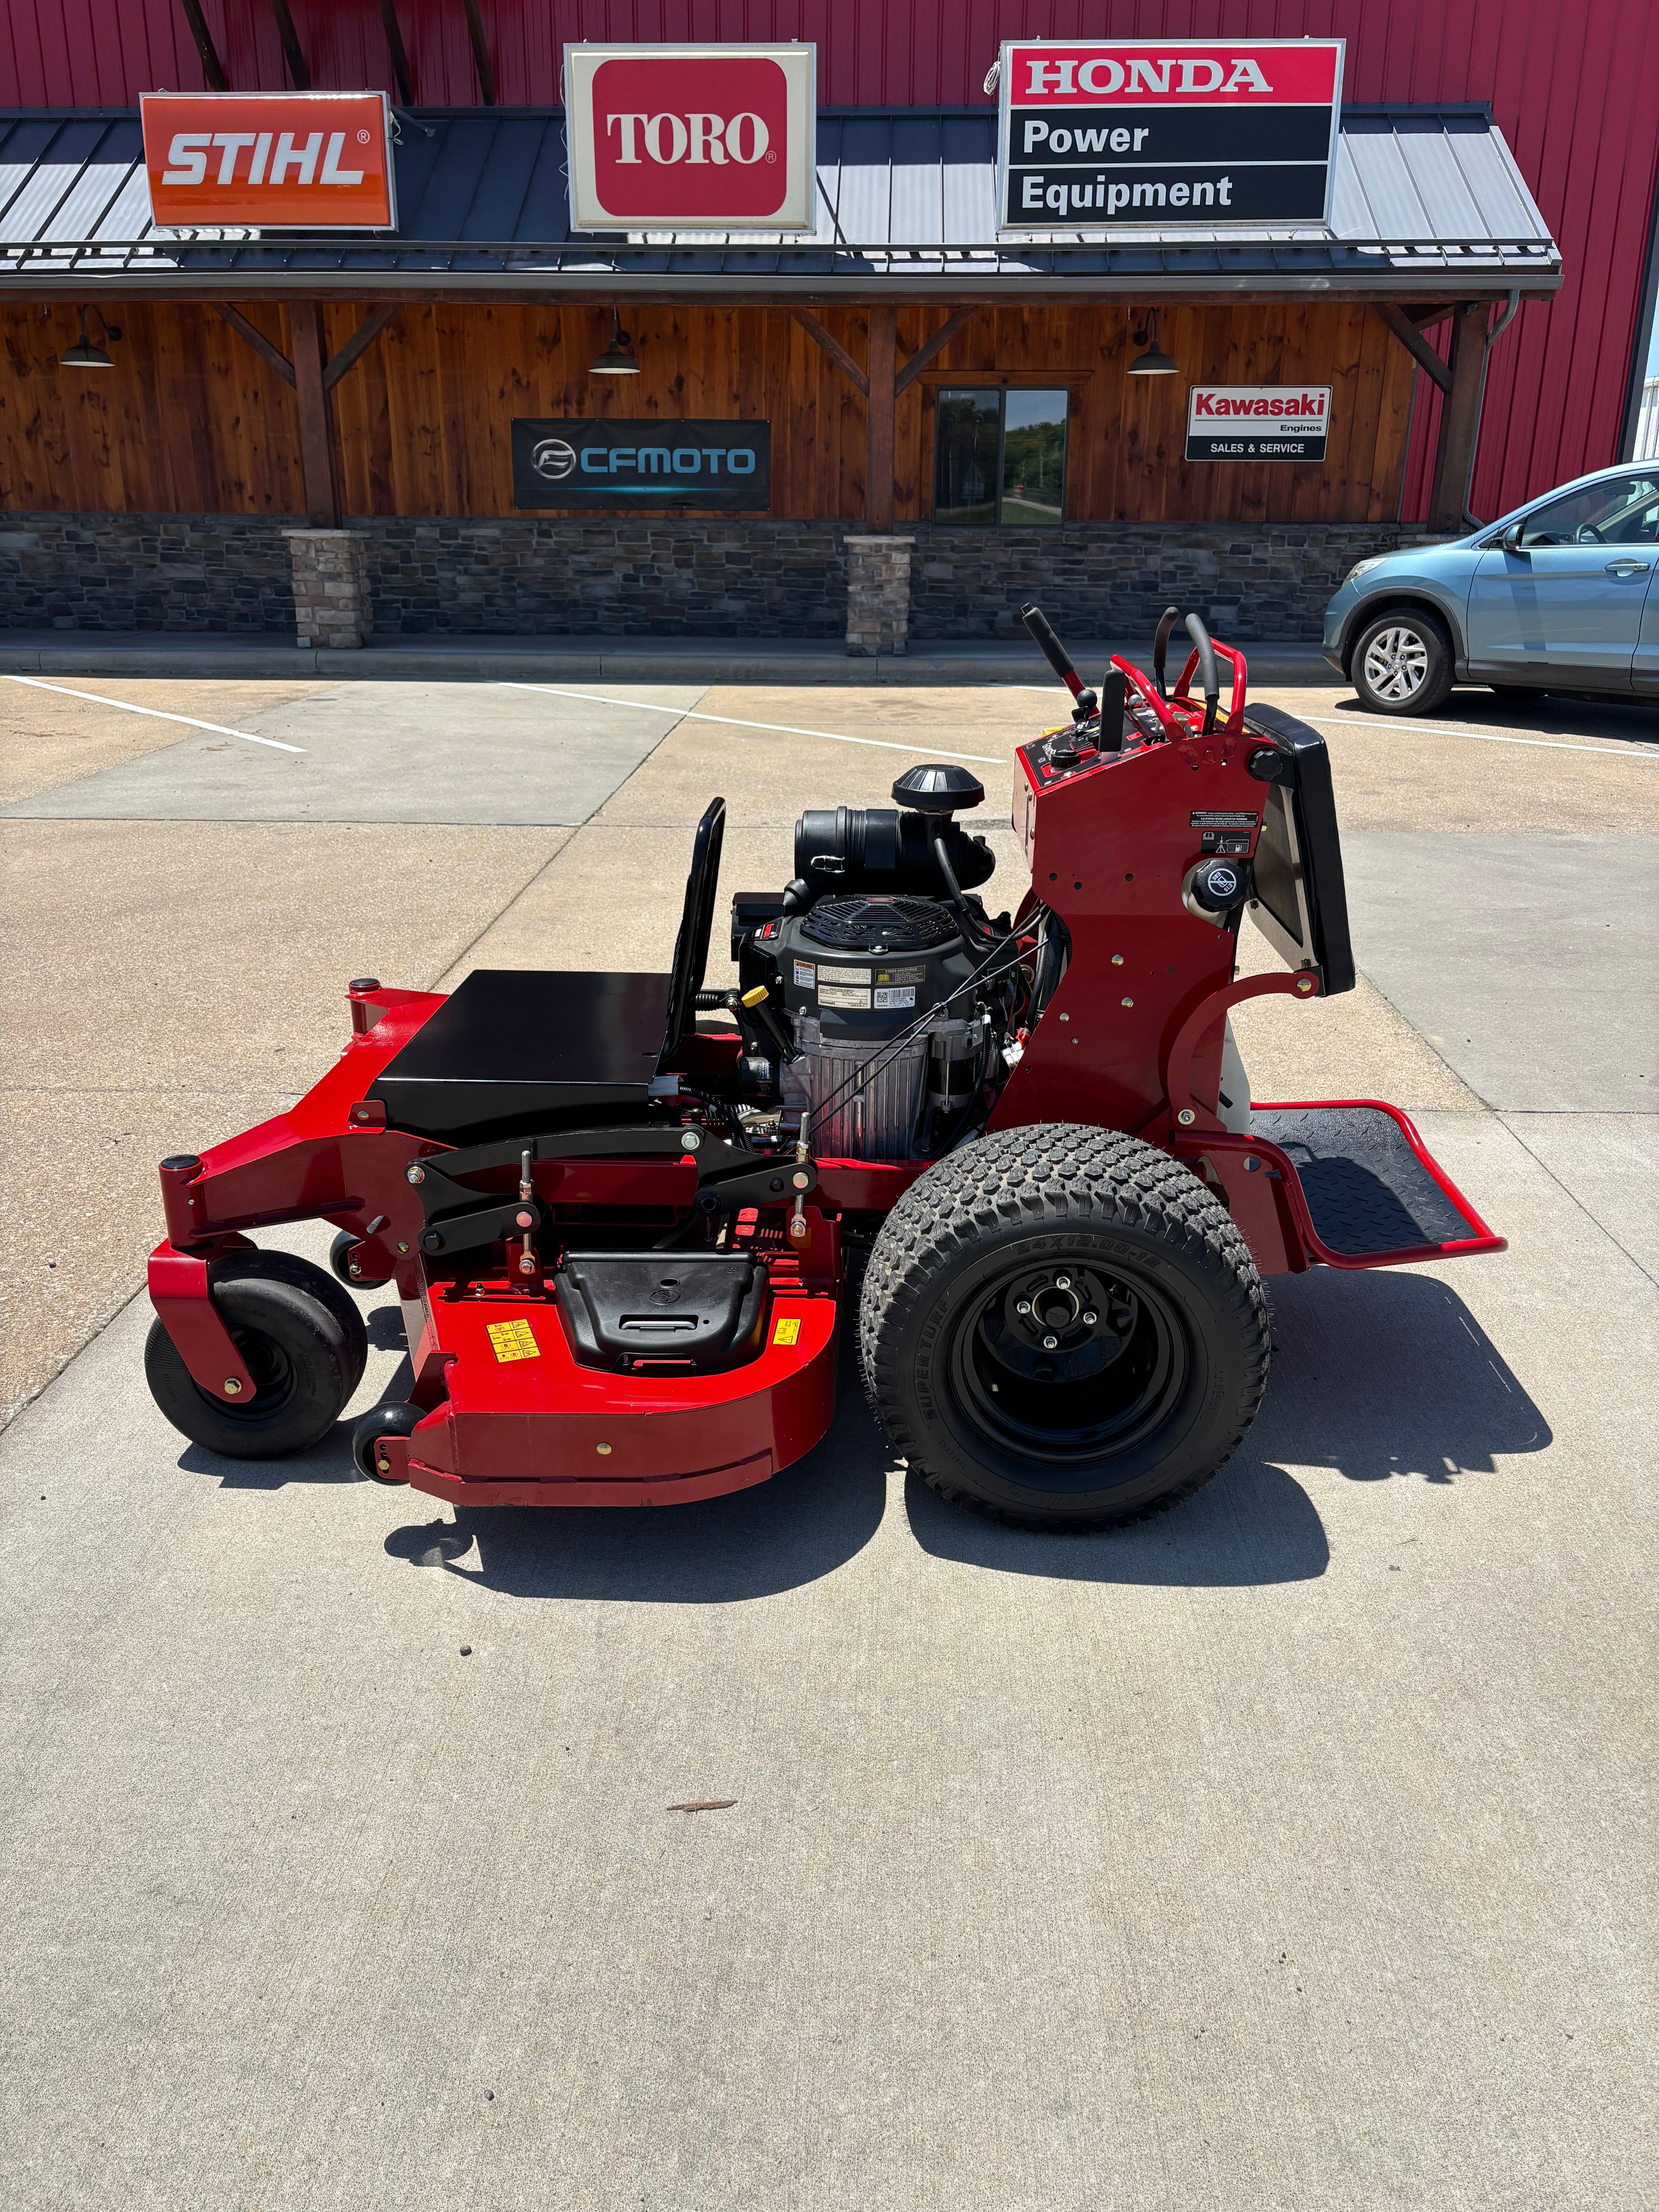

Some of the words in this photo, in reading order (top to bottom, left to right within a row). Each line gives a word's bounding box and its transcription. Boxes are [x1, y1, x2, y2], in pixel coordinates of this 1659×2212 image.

[1025, 58, 1274, 94] HONDA
[606, 112, 769, 165] TORO
[1023, 120, 1149, 153] Power
[161, 132, 365, 185] STIHL
[1021, 174, 1233, 216] Equipment
[1195, 393, 1325, 416] Kawasaki
[1280, 424, 1322, 433] Engines
[580, 447, 756, 474] CFMOTO
[1210, 443, 1244, 453] SALES
[1247, 444, 1255, 453] &
[1259, 443, 1305, 453] SERVICE
[1018, 1235, 1161, 1269] 24X12.00-12
